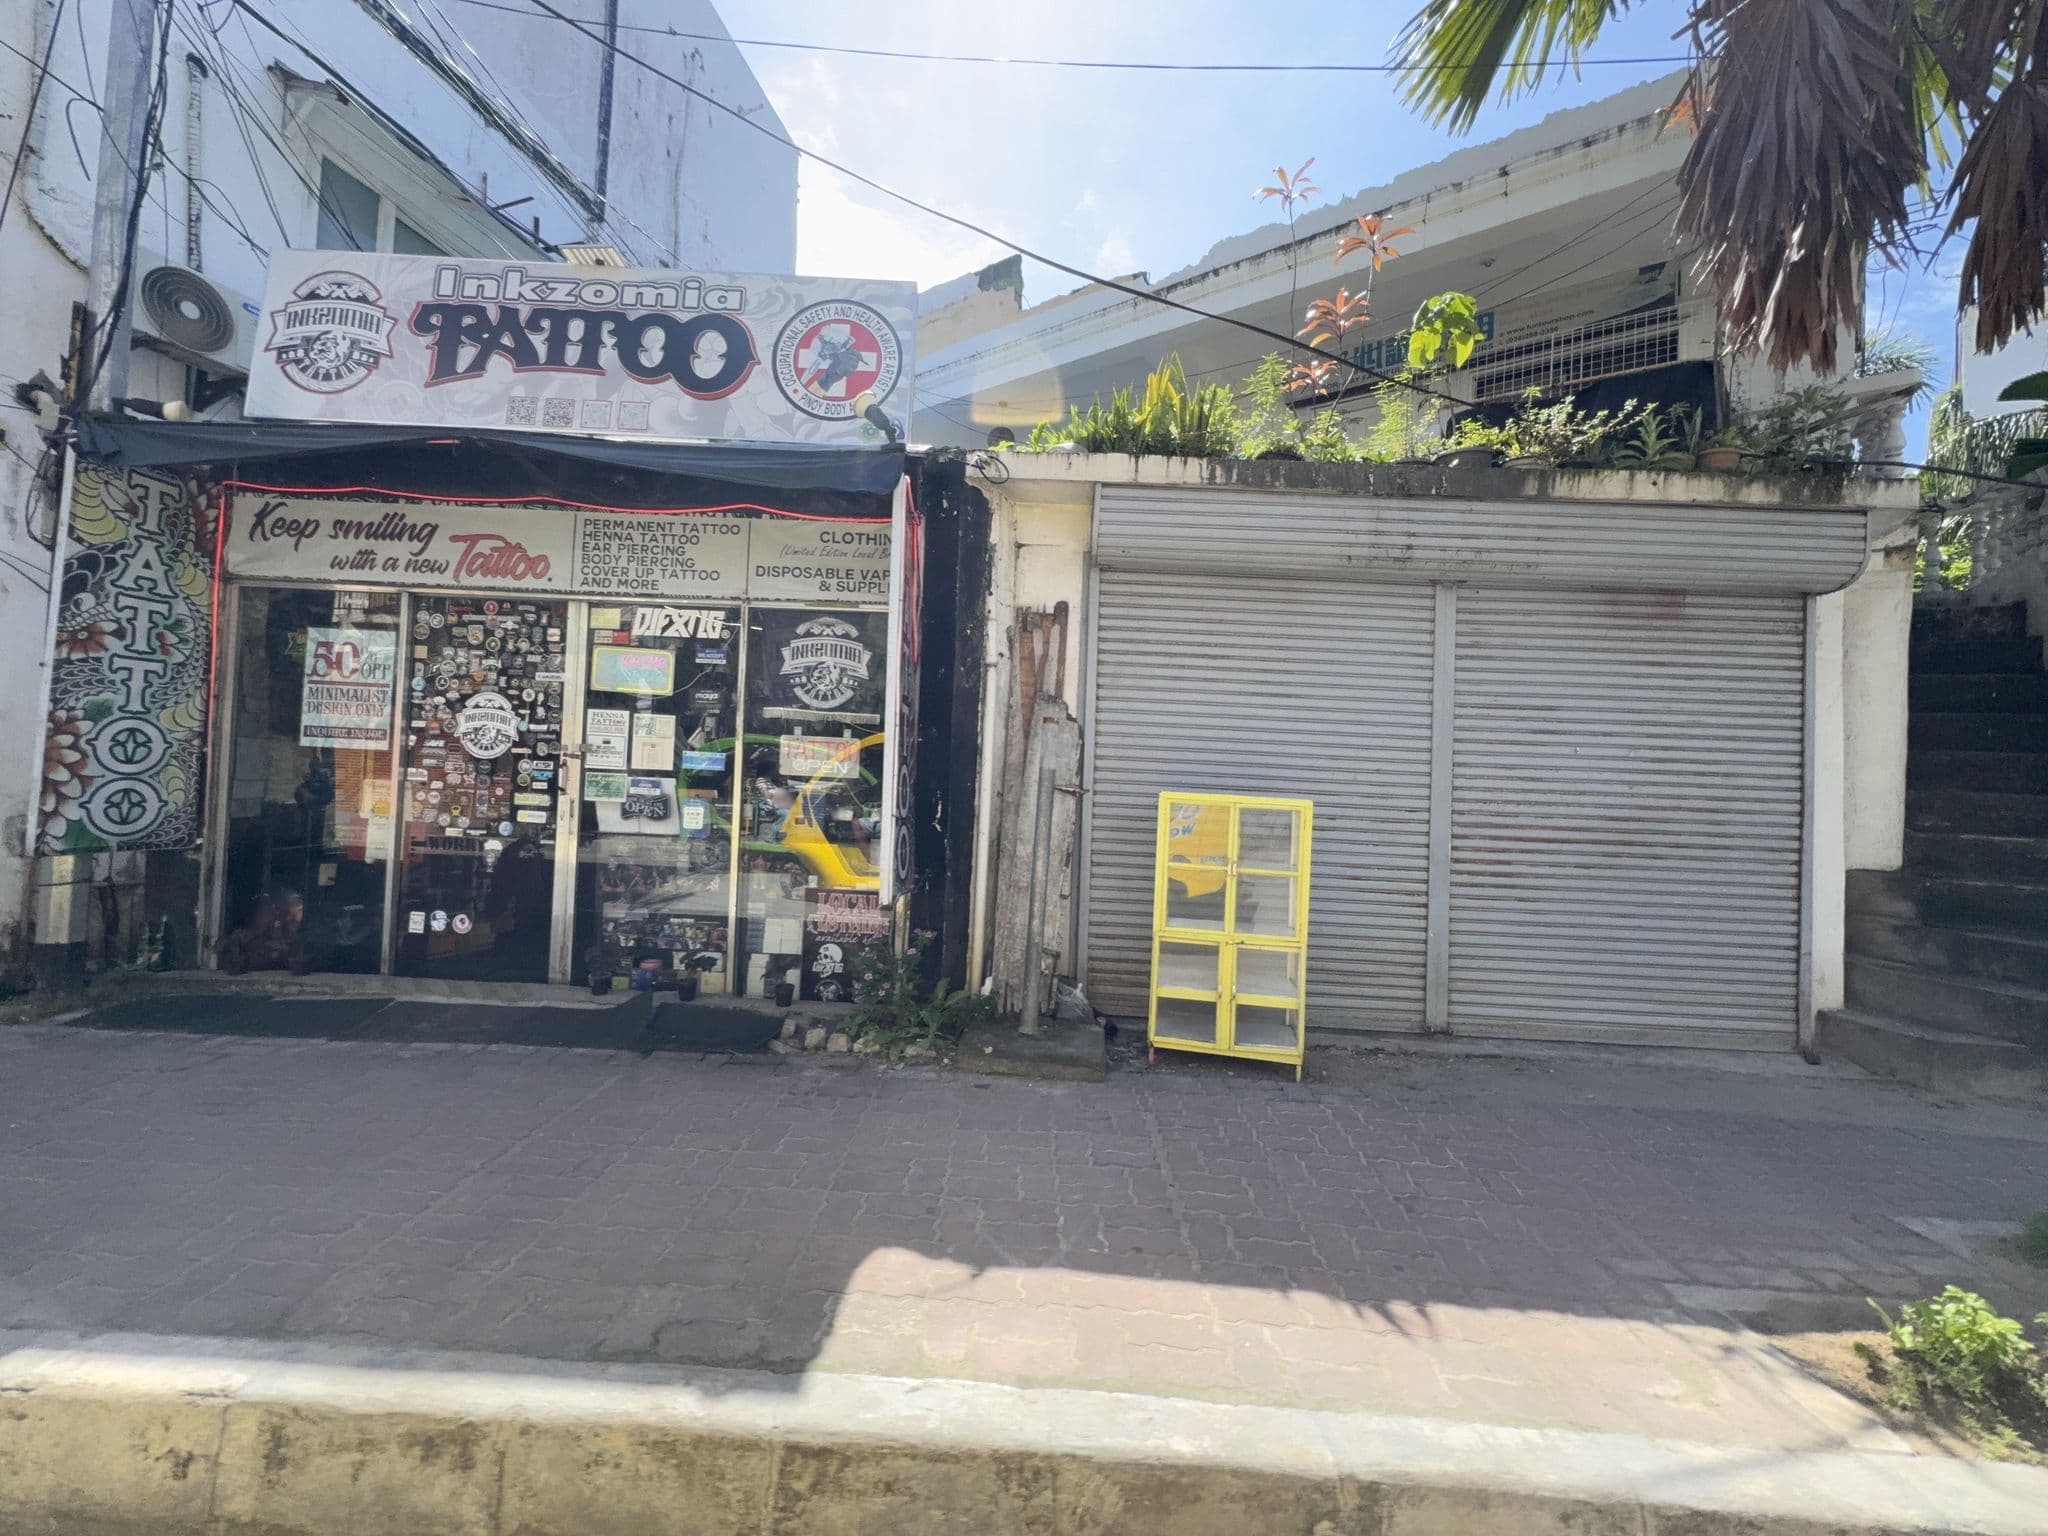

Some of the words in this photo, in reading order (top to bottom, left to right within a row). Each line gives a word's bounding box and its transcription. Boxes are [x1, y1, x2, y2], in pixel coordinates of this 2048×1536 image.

[436, 266, 748, 313] Inkzomia
[800, 307, 832, 330] SAFETY
[834, 306, 852, 319] AND
[853, 311, 882, 336] HEALTH
[408, 302, 760, 400] TATTOO
[879, 332, 896, 363] AWARE
[779, 326, 804, 388] OCCUPATIONAL
[874, 363, 896, 394] ARTIST
[799, 394, 821, 411] PINOY
[825, 402, 847, 415] BODY
[249, 501, 320, 552] Keep
[328, 511, 439, 546] smiling
[583, 518, 677, 534] PERMANENT
[680, 523, 741, 536] TATTOO
[582, 530, 637, 543] HENNA
[640, 533, 700, 546] TATTOO
[819, 530, 892, 546] CLOTHIN
[581, 542, 614, 554] EAR
[617, 543, 686, 557] PIERCING
[819, 545, 850, 559] Edition
[852, 546, 878, 560] Local
[330, 548, 378, 574] with
[381, 556, 399, 572] a
[404, 558, 449, 576] new
[581, 553, 622, 566] BODY
[625, 555, 696, 569] PIERCING
[580, 565, 629, 579] COVER
[634, 567, 654, 579] UP
[660, 568, 721, 582] TATTOO
[755, 564, 855, 581] DISPOSABLE
[860, 569, 891, 582] VAP
[579, 577, 613, 590] AND
[617, 579, 660, 591] MORE
[818, 580, 832, 593] &
[79, 469, 182, 837] TATTOO
[361, 662, 392, 680] OFF
[308, 686, 389, 704] MINIMALIST
[306, 701, 351, 716] DESIGN
[355, 702, 386, 718] ONLY
[592, 711, 625, 720] HENNA
[306, 726, 349, 738] INQUIRE
[350, 727, 386, 740] INSIDE
[625, 800, 665, 817] OPEN
